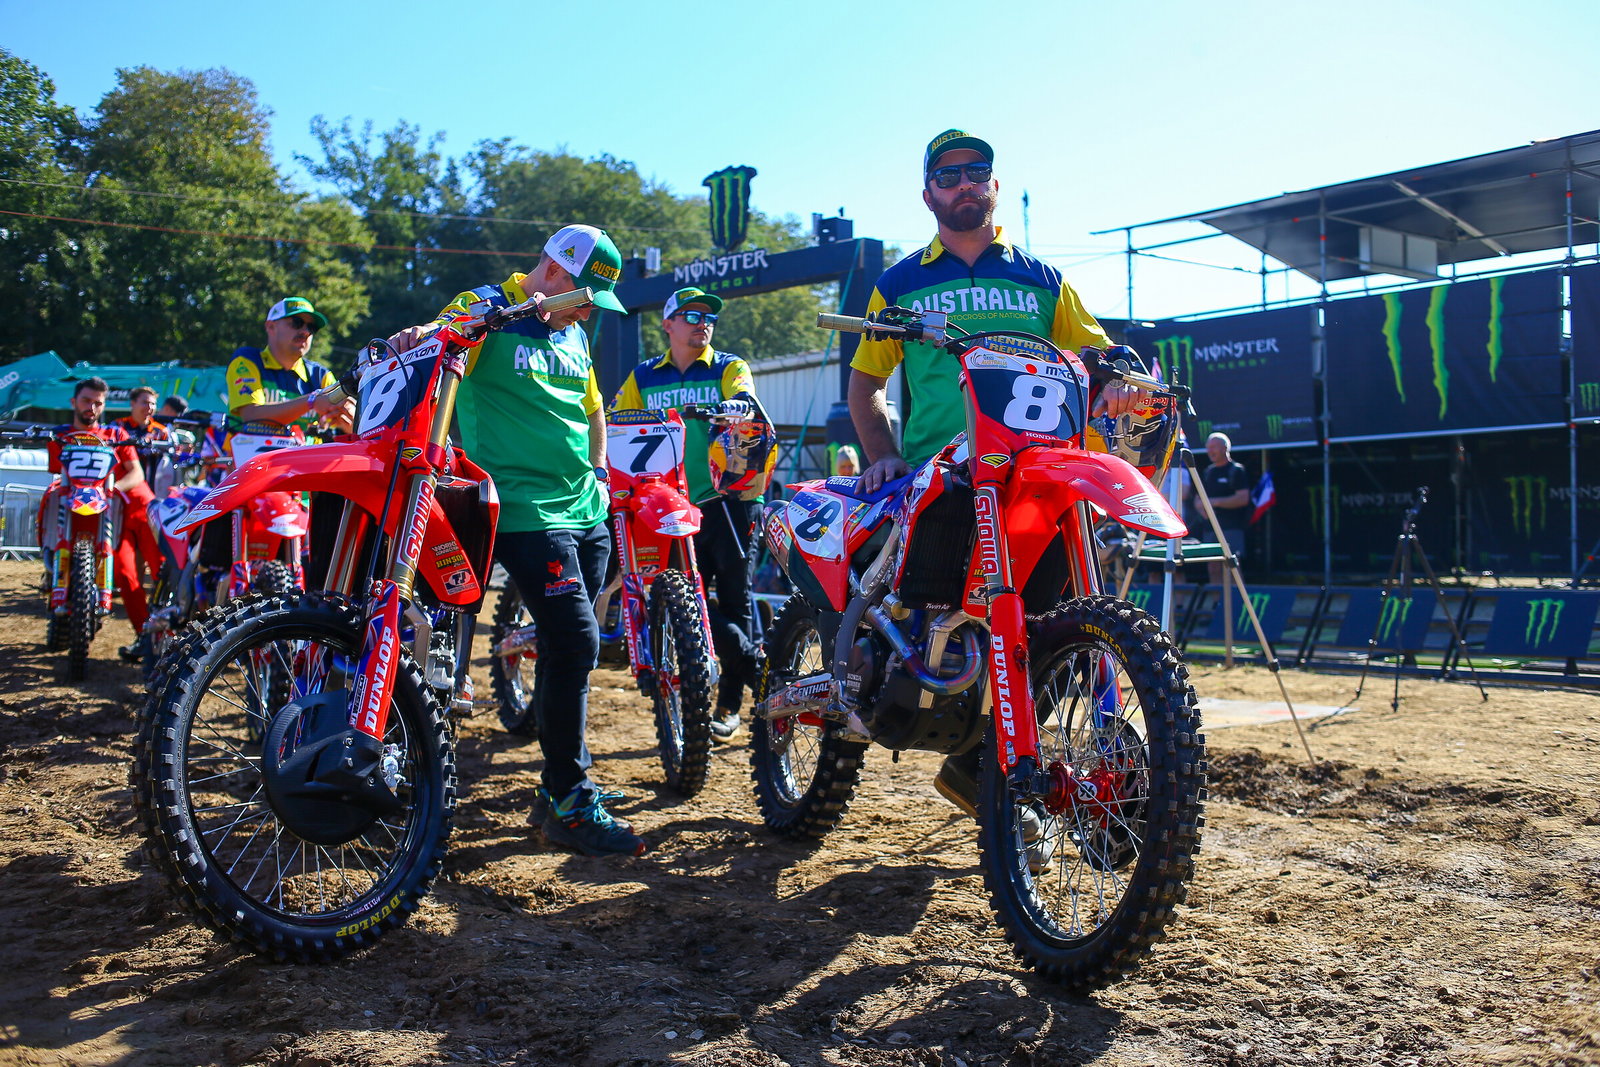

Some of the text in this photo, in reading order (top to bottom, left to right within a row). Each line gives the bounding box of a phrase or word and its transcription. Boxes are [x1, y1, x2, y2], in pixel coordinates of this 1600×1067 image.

[931, 131, 970, 151] AUSTRA
[674, 249, 769, 283] MONSTER
[699, 276, 756, 293] NERGY
[911, 286, 1041, 315] AUSTRALIA
[946, 313, 987, 321] OTOCROSS
[999, 312, 1029, 321] NATIONS
[1194, 337, 1280, 362] MONSTER
[357, 365, 414, 434] 8
[646, 386, 720, 410] AUSTRALIA
[1003, 374, 1066, 432] 8
[629, 434, 668, 474] 7
[1025, 431, 1058, 441] HONDA
[67, 451, 112, 479] 23
[405, 480, 435, 565] SHOWA
[795, 500, 842, 543] 8
[974, 495, 999, 577] SHOWA
[365, 626, 394, 733] DUNLOP
[991, 634, 1016, 737] DUNLOP
[336, 895, 401, 937] DUNLOP
